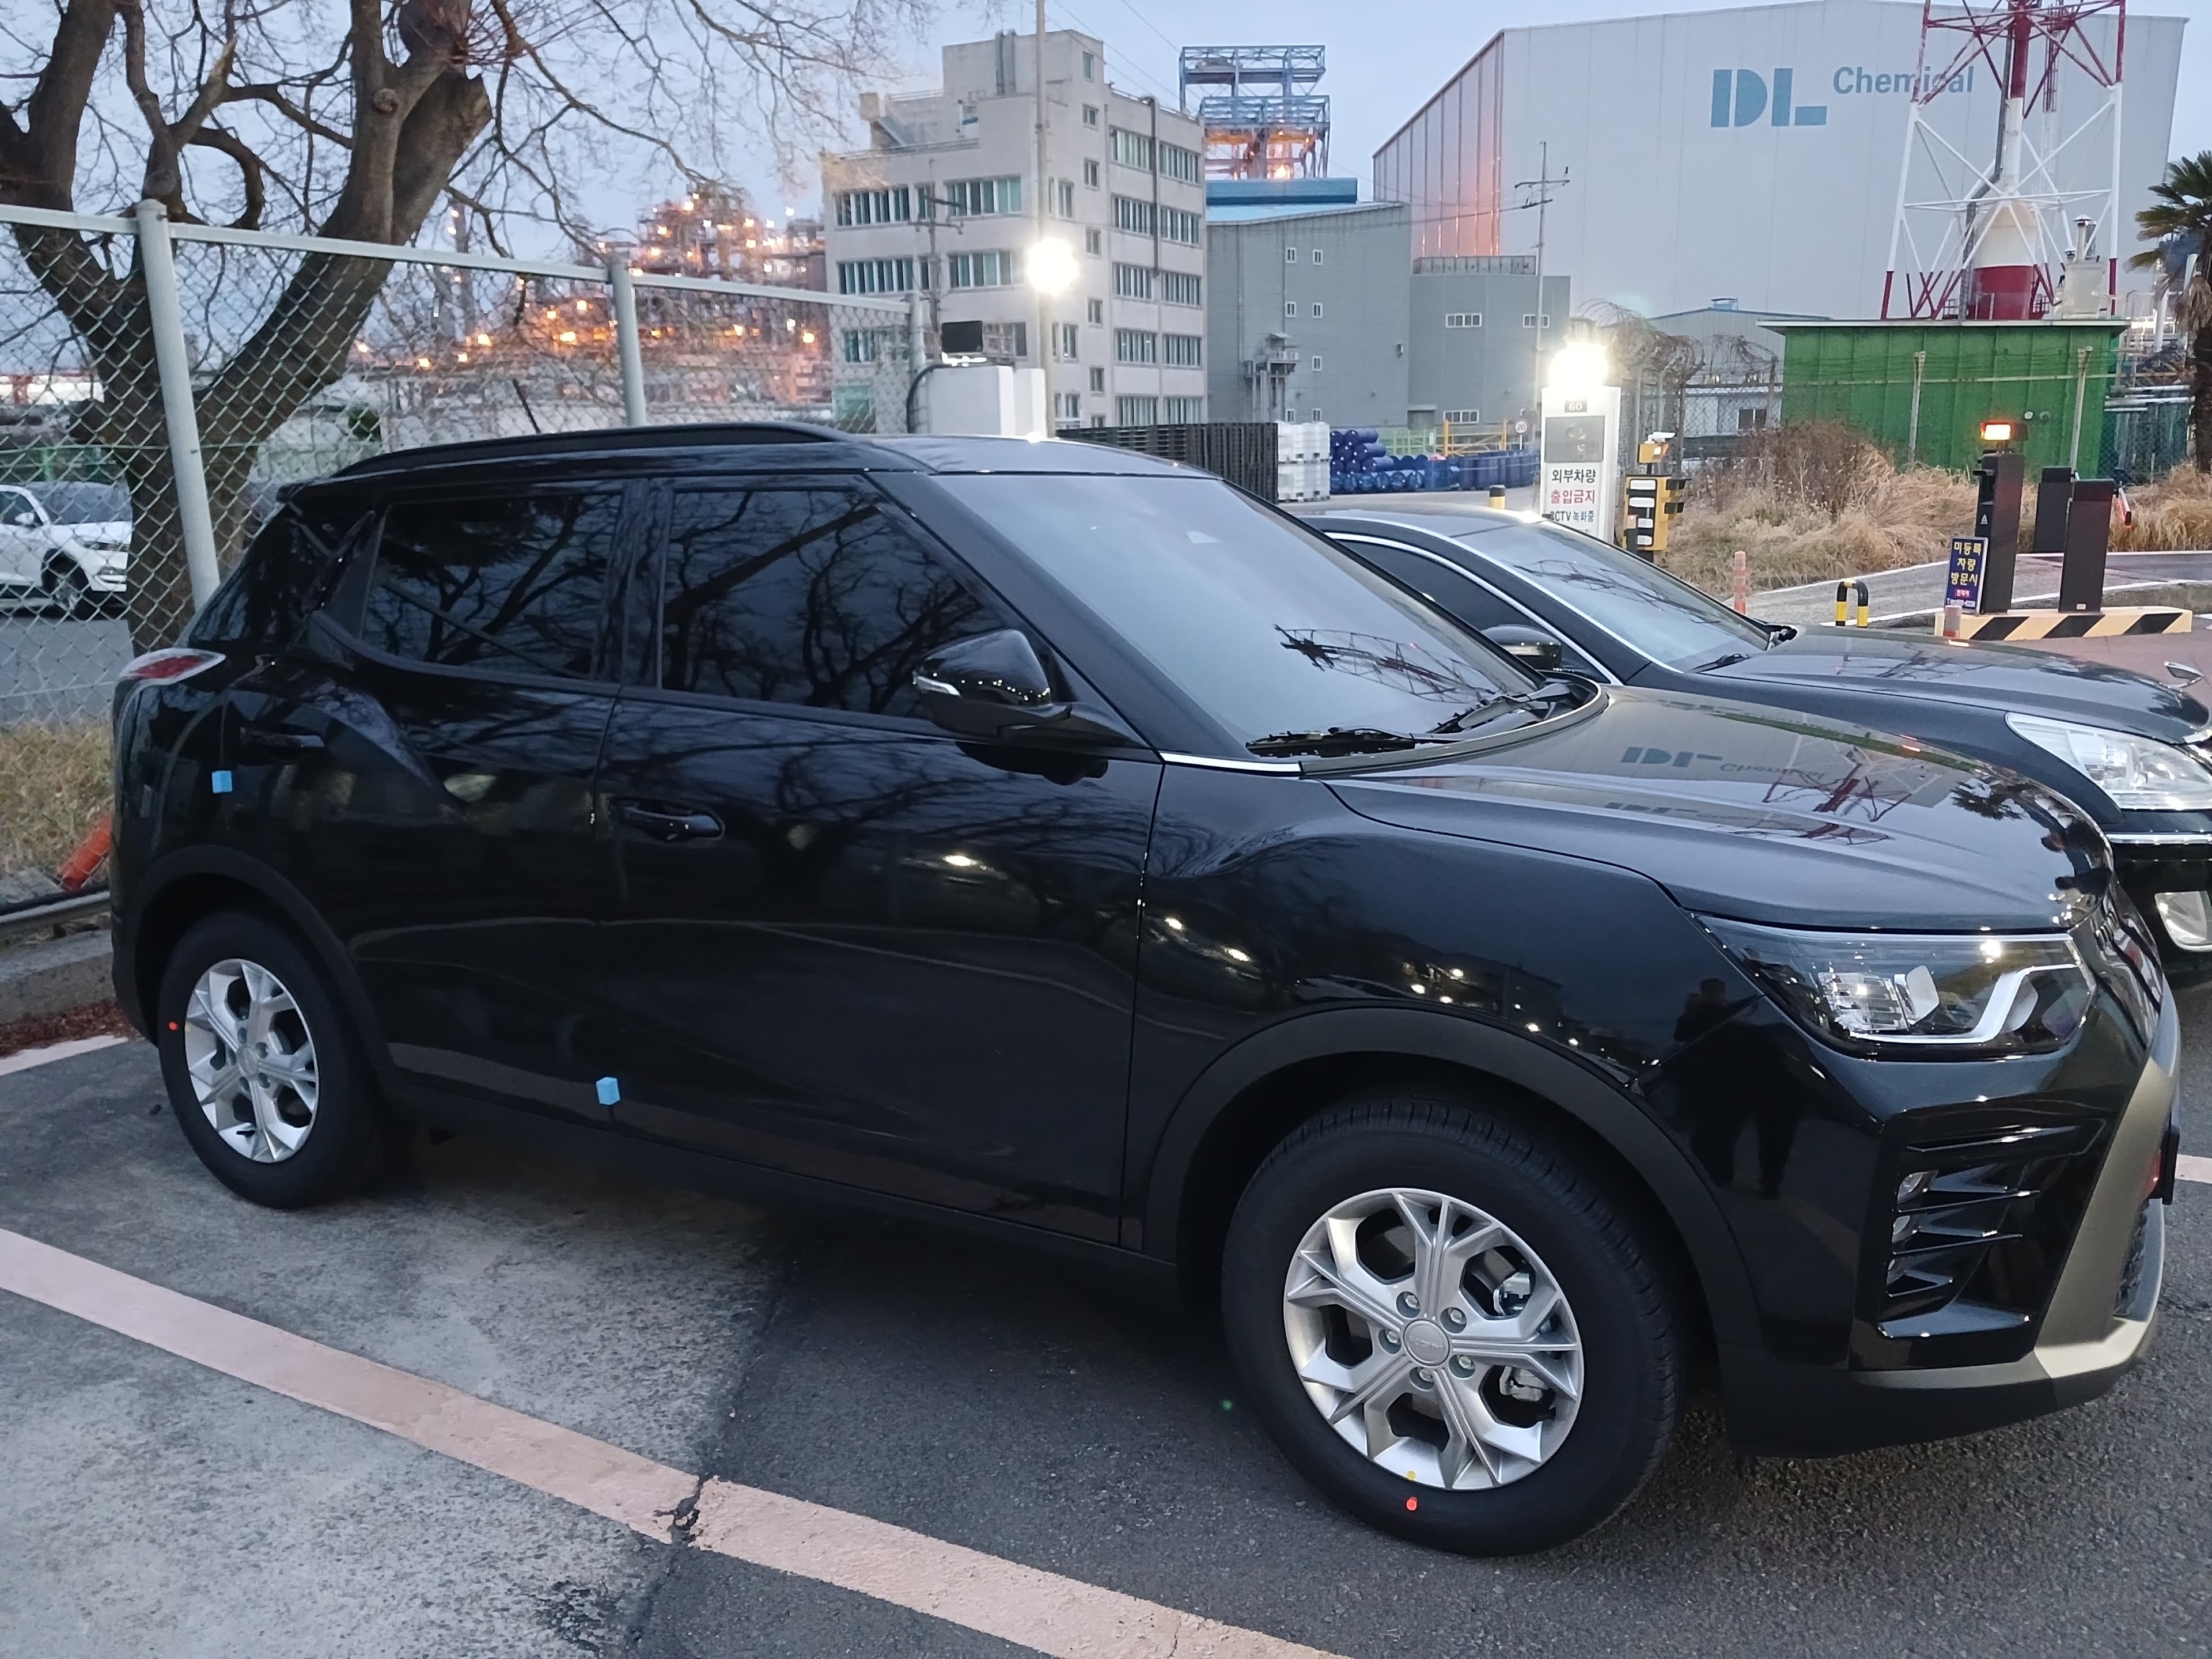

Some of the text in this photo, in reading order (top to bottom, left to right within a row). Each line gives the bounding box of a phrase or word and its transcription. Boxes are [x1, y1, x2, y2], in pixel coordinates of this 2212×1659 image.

[1711, 66, 1974, 127] DL Chemical
[1568, 402, 1583, 411] 60
[1551, 469, 1596, 483] 외부차량
[1551, 489, 1595, 504] 출입금지
[1573, 510, 1594, 522] 녹화중
[1953, 541, 1982, 556] 미등록
[1957, 558, 1976, 571] 차량
[1950, 572, 1978, 586] 방문시
